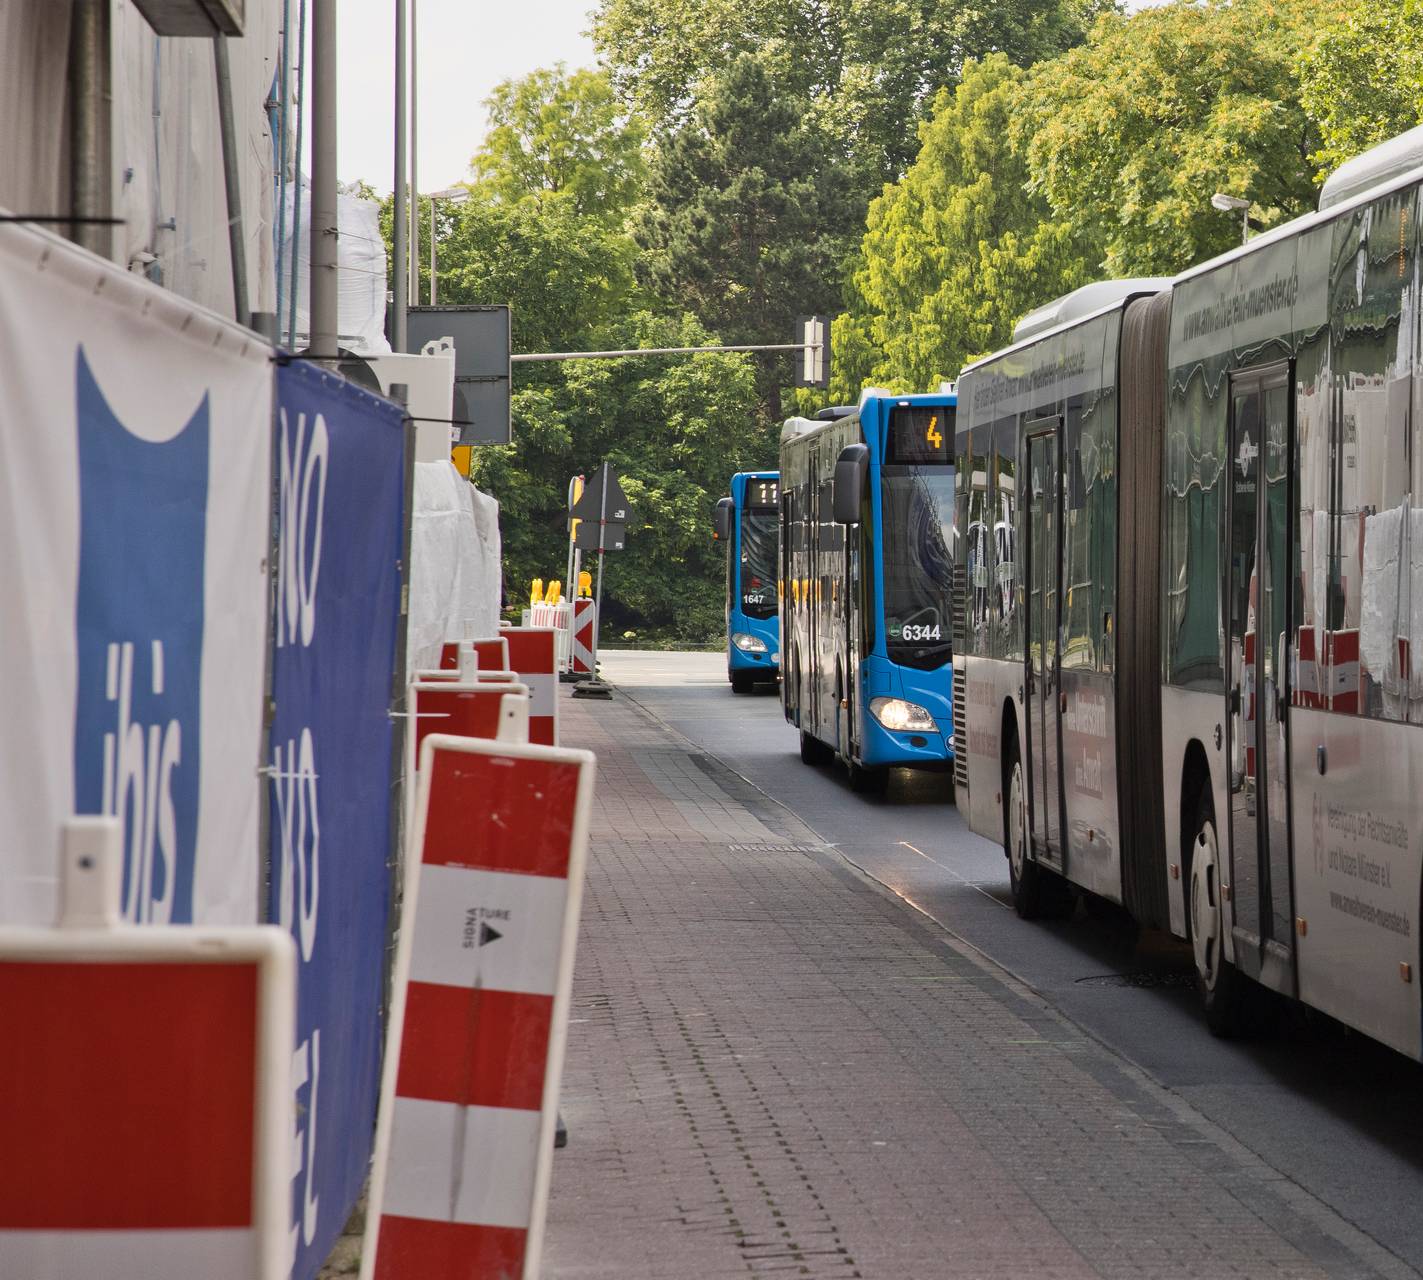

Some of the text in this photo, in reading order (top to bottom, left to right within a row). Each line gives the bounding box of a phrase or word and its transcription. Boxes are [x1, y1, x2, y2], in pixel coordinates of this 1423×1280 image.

[927, 416, 943, 448] 4
[759, 483, 777, 504] 11
[277, 407, 329, 648] NO
[743, 594, 764, 604] 1647
[902, 624, 941, 641] 6344
[102, 640, 181, 926] ibis
